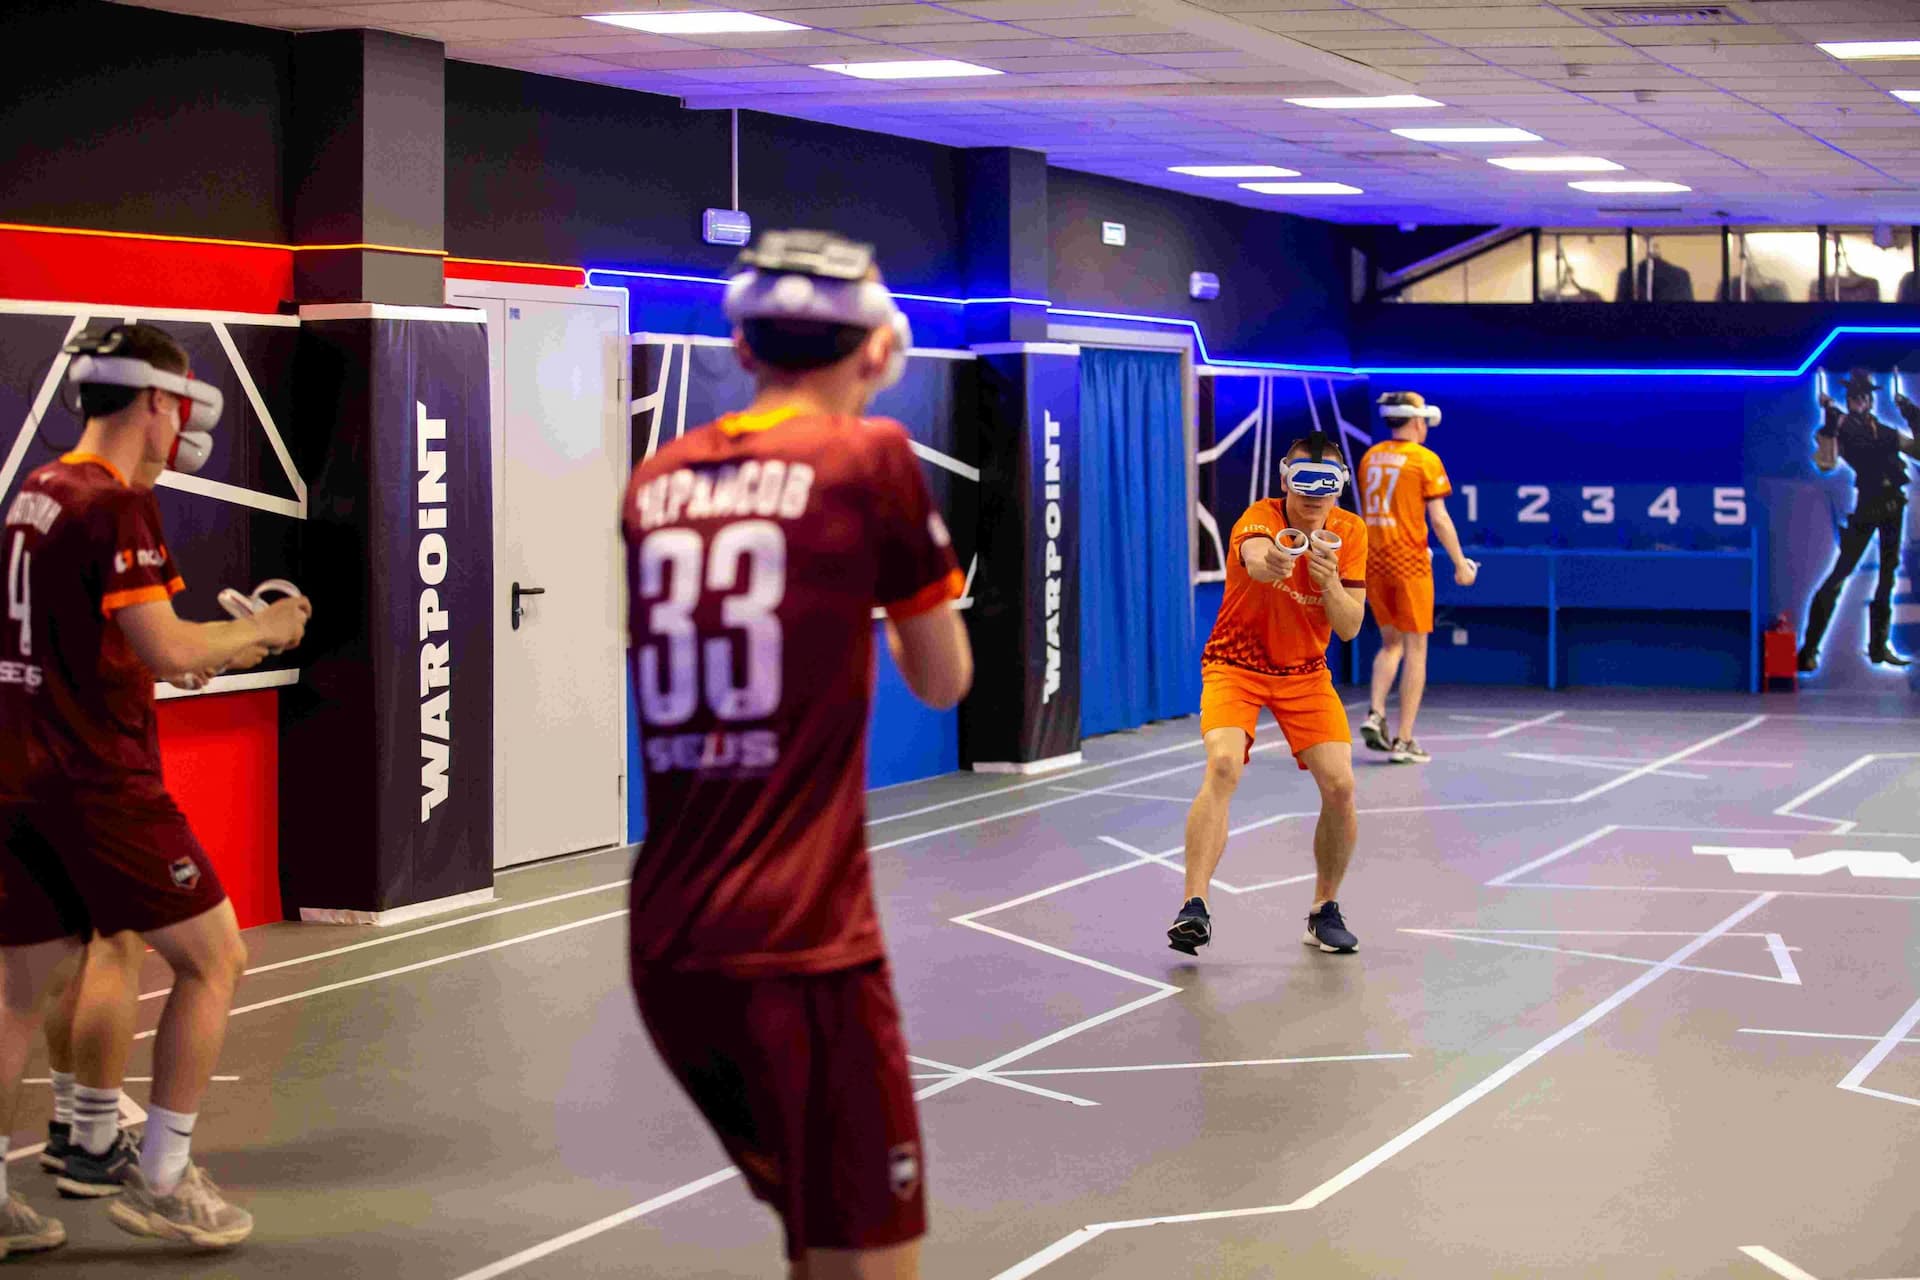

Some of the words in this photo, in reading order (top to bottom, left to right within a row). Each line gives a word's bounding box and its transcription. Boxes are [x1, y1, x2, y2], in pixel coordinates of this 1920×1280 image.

[1043, 408, 1062, 705] WARPOINT
[1365, 466, 1400, 515] 27
[1460, 484, 1478, 523] 1
[1516, 485, 1551, 523] 2
[1581, 485, 1616, 525] 3
[1647, 486, 1681, 525] 4
[1713, 486, 1748, 526] 5
[8, 530, 32, 656] 4
[416, 400, 451, 824] WARPOINT
[639, 518, 787, 726] 33
